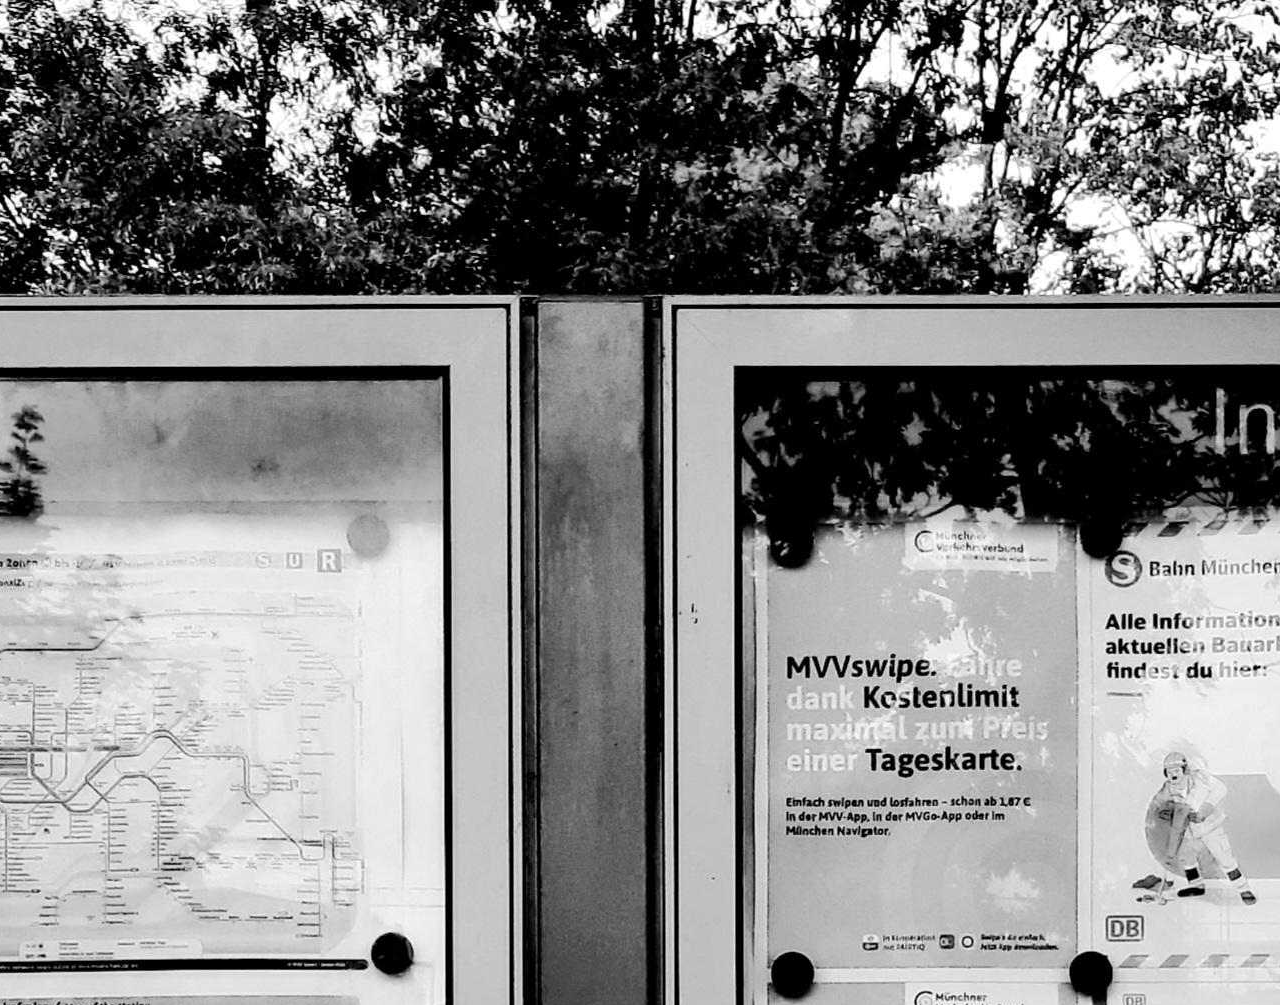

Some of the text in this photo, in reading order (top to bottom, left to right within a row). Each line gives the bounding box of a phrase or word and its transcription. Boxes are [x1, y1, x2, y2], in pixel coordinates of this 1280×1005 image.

[1150, 561, 1195, 577] Bahn
[1105, 613, 1147, 630] Alle
[1105, 637, 1205, 655] aktuellen
[786, 654, 937, 683] MVVswipe.
[1106, 660, 1268, 680] findest du hier:
[786, 683, 1020, 710] dank Kostenlimit
[786, 714, 1049, 741] maximal zum Preis
[786, 746, 1023, 778] einer Tageskarte.
[786, 797, 825, 808] Einfach
[827, 798, 864, 811] swipen
[867, 797, 887, 808] und
[890, 796, 939, 808] losfahren
[950, 796, 981, 808] schon
[983, 797, 997, 807] ab
[1023, 797, 1032, 807] €
[786, 811, 796, 822] in
[798, 811, 817, 822] der
[872, 811, 883, 822] in
[885, 811, 904, 822] der
[906, 811, 962, 824] MVGo-App
[965, 810, 989, 821] oder
[991, 811, 1005, 821] im
[786, 825, 834, 837] München
[1108, 917, 1141, 939] DB
[935, 992, 987, 1003] Münchner
